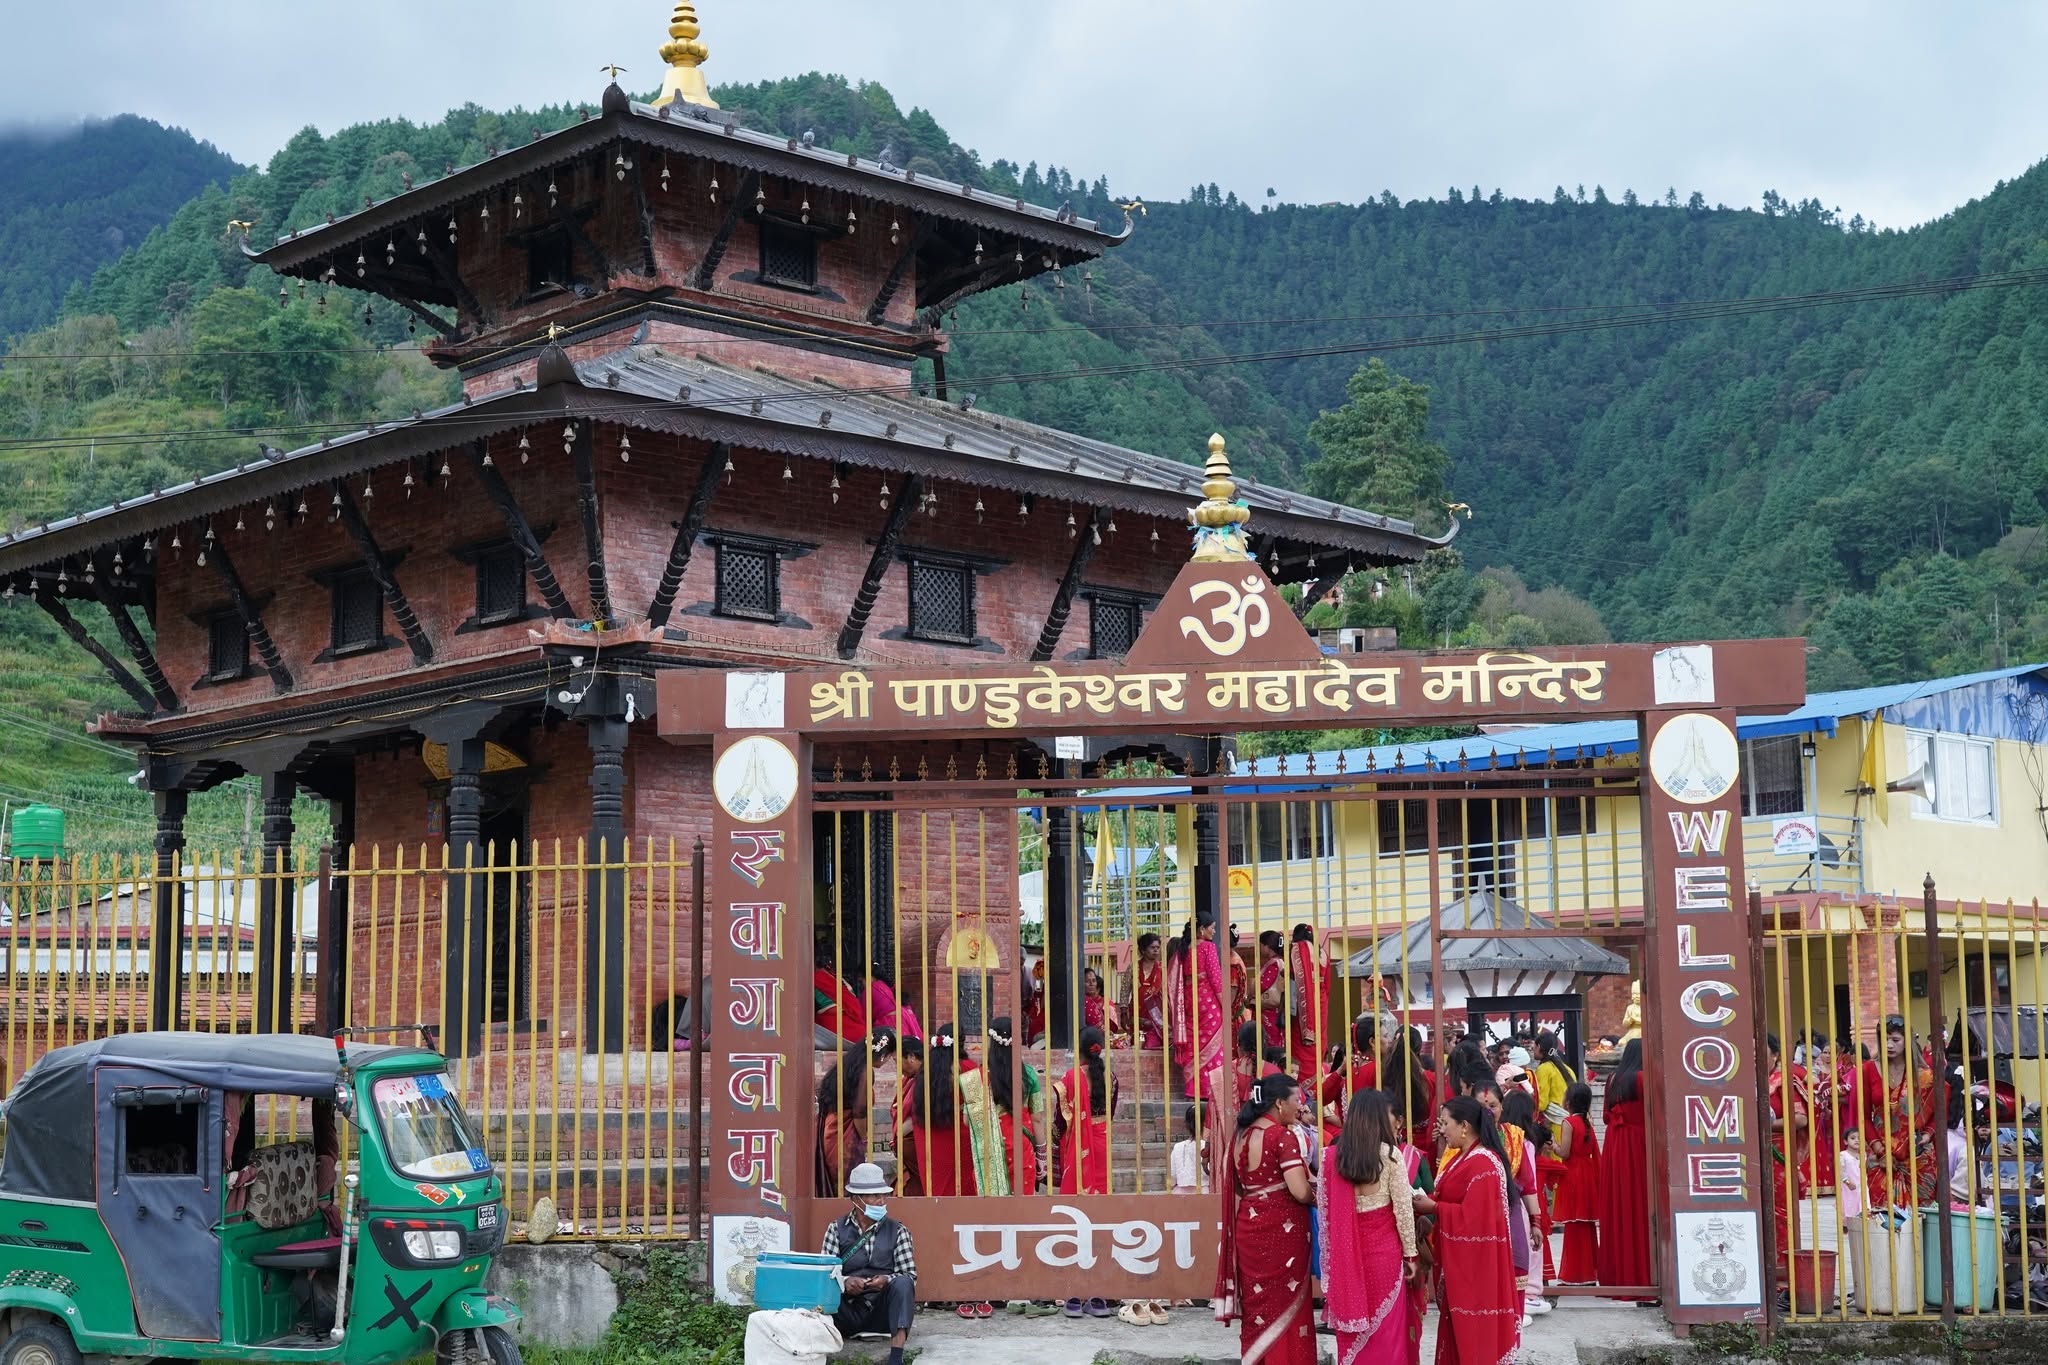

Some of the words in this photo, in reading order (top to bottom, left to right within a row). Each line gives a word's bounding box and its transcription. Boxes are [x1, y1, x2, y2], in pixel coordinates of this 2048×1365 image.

[1180, 576, 1270, 656] ॐ
[809, 671, 874, 723] श्री
[889, 665, 1187, 729] पाण्डुकेश्वर
[1205, 657, 1400, 713] महादेव
[1421, 651, 1606, 703] मन्दिर
[727, 829, 784, 1206] स्वागतम्
[1667, 810, 1748, 1198] WELCOME
[952, 1204, 1200, 1275] प्रवेश
